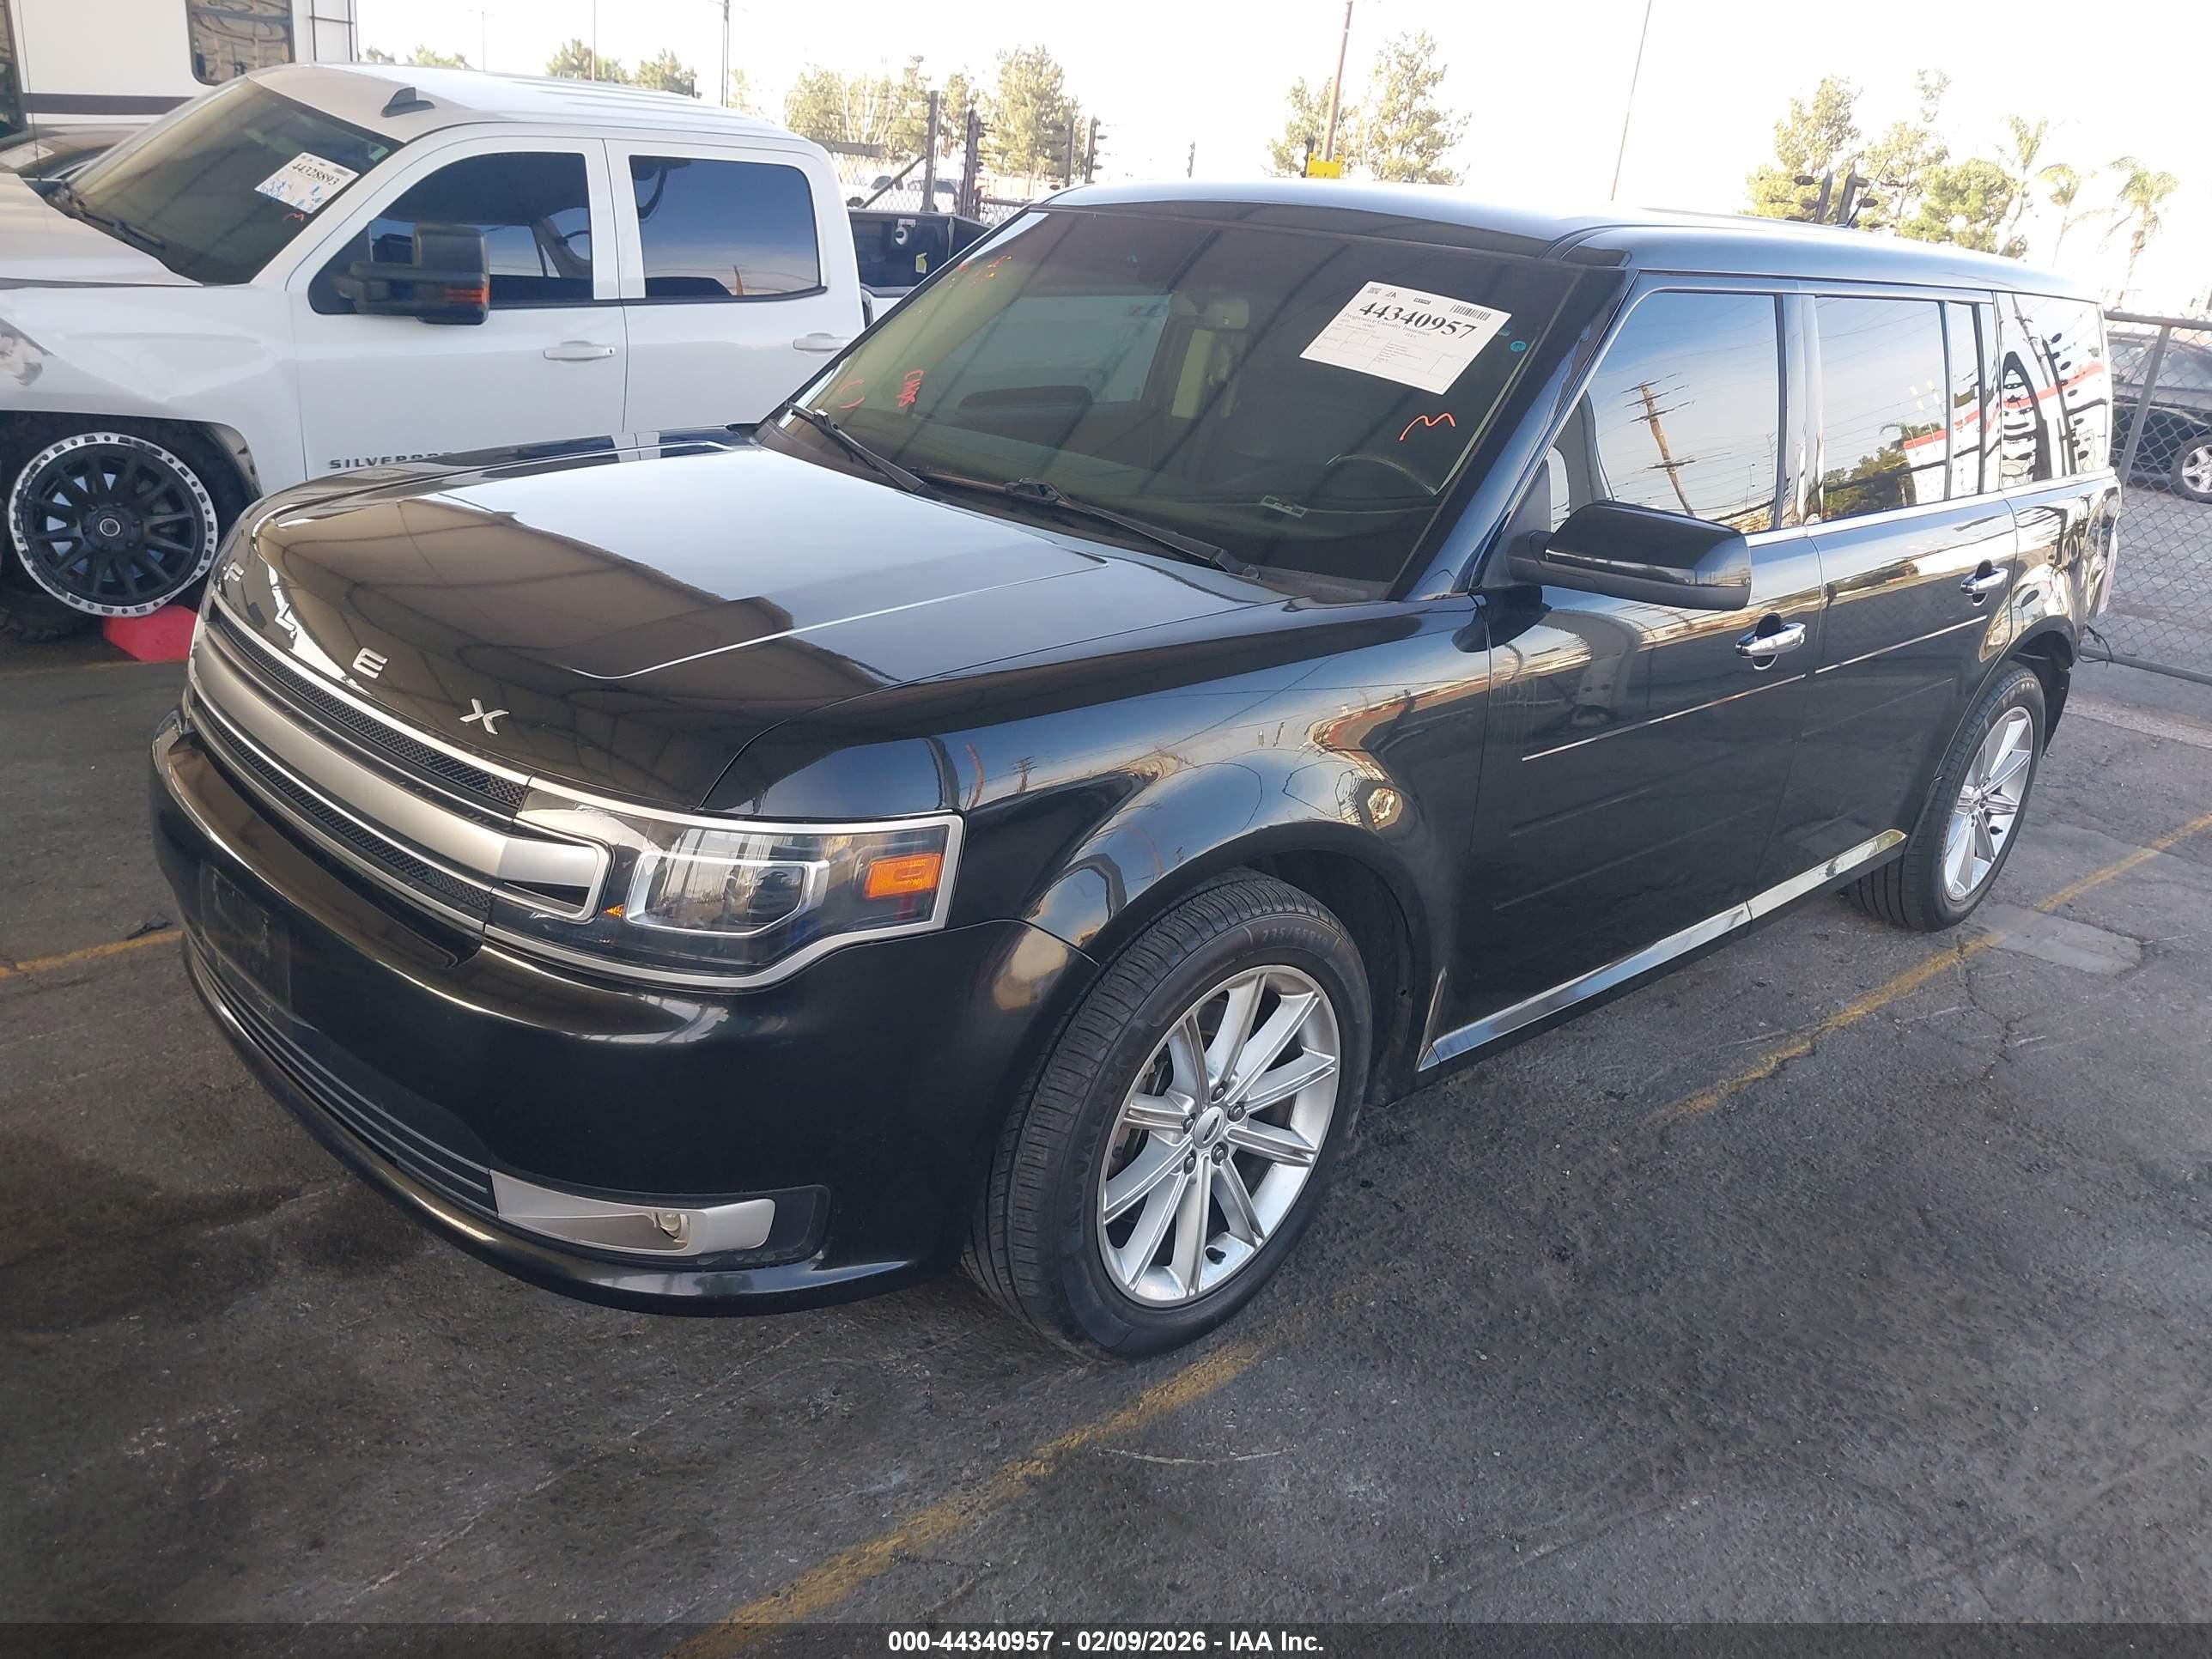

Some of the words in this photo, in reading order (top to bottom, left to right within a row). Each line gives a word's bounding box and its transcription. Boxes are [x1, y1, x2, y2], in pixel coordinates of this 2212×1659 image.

[292, 163, 340, 185] 44328893
[1359, 301, 1478, 339] 44340957
[329, 453, 453, 469] SILVER
[223, 561, 510, 735] FLEX
